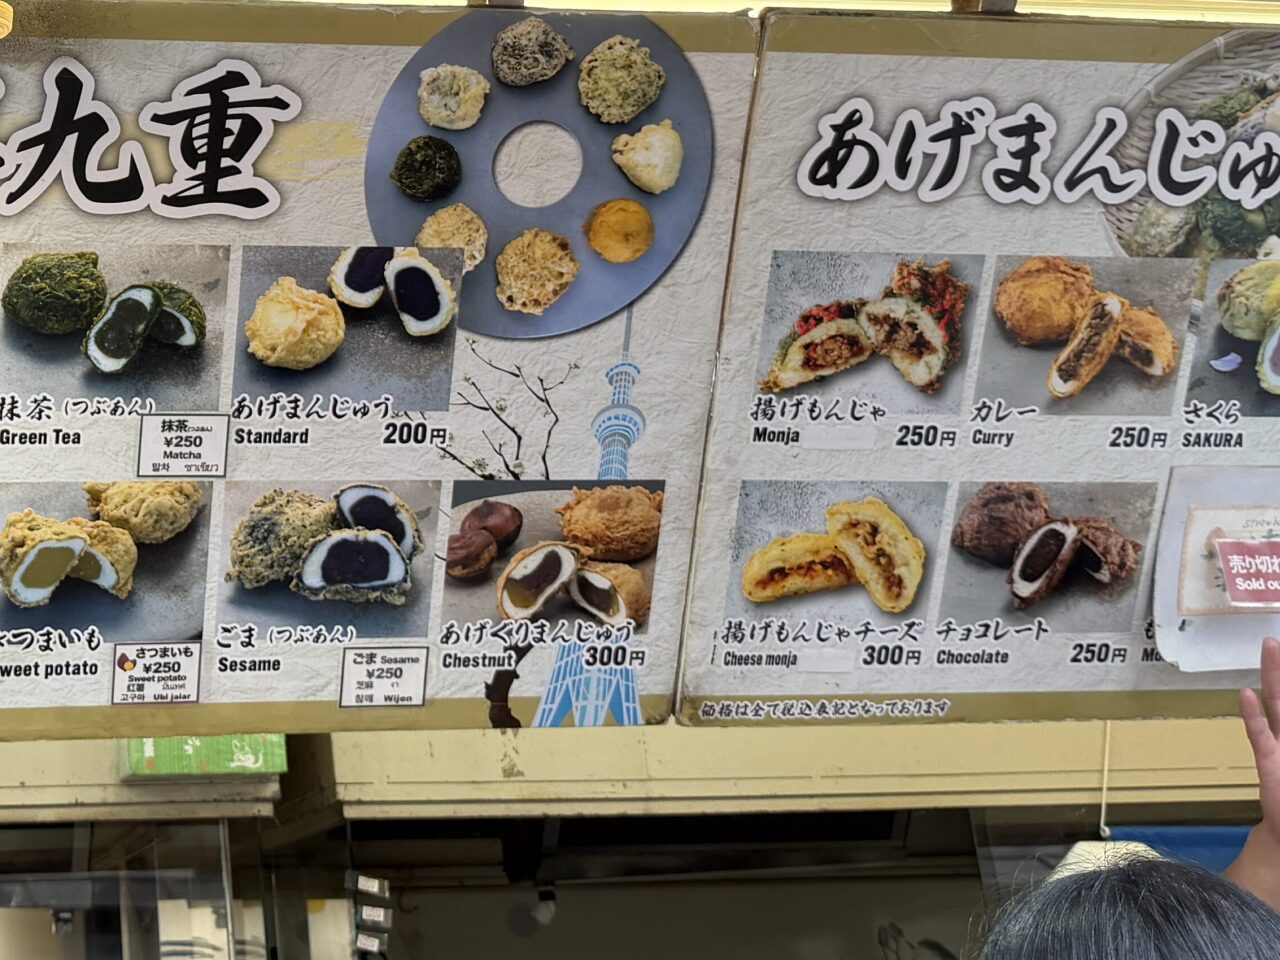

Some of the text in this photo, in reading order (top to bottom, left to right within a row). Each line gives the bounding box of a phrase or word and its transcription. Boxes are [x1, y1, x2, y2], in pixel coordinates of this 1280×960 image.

[807, 106, 1280, 199] あげまんじゅ
[231, 396, 391, 419] あげまんじゅう
[750, 397, 886, 421] 揚げもんじゃ
[970, 400, 1037, 422] カレー
[1183, 401, 1241, 424] さくら
[0, 428, 81, 445] Green Tea
[163, 436, 203, 448] ¥250
[234, 428, 309, 444] Standard
[752, 426, 800, 446] Monja
[971, 429, 1014, 447] Curry
[1182, 432, 1244, 448] SAKURA
[163, 451, 202, 460] Matcha
[1235, 577, 1266, 590] Sold
[216, 625, 256, 648] ごま
[721, 620, 921, 644] 揚げもんじゃチーズ
[936, 618, 1050, 641] チョコレート
[135, 646, 194, 659] さつまいも
[352, 652, 420, 665] ごま Sesame
[442, 652, 514, 669] Chestnut
[723, 650, 798, 669] Cheese monja
[936, 648, 1009, 665] Chocolate
[45, 660, 99, 680] potato
[142, 661, 182, 674] ¥250
[218, 656, 281, 672] Sesame
[128, 675, 187, 684] Sweet potato
[365, 667, 403, 679] ¥250
